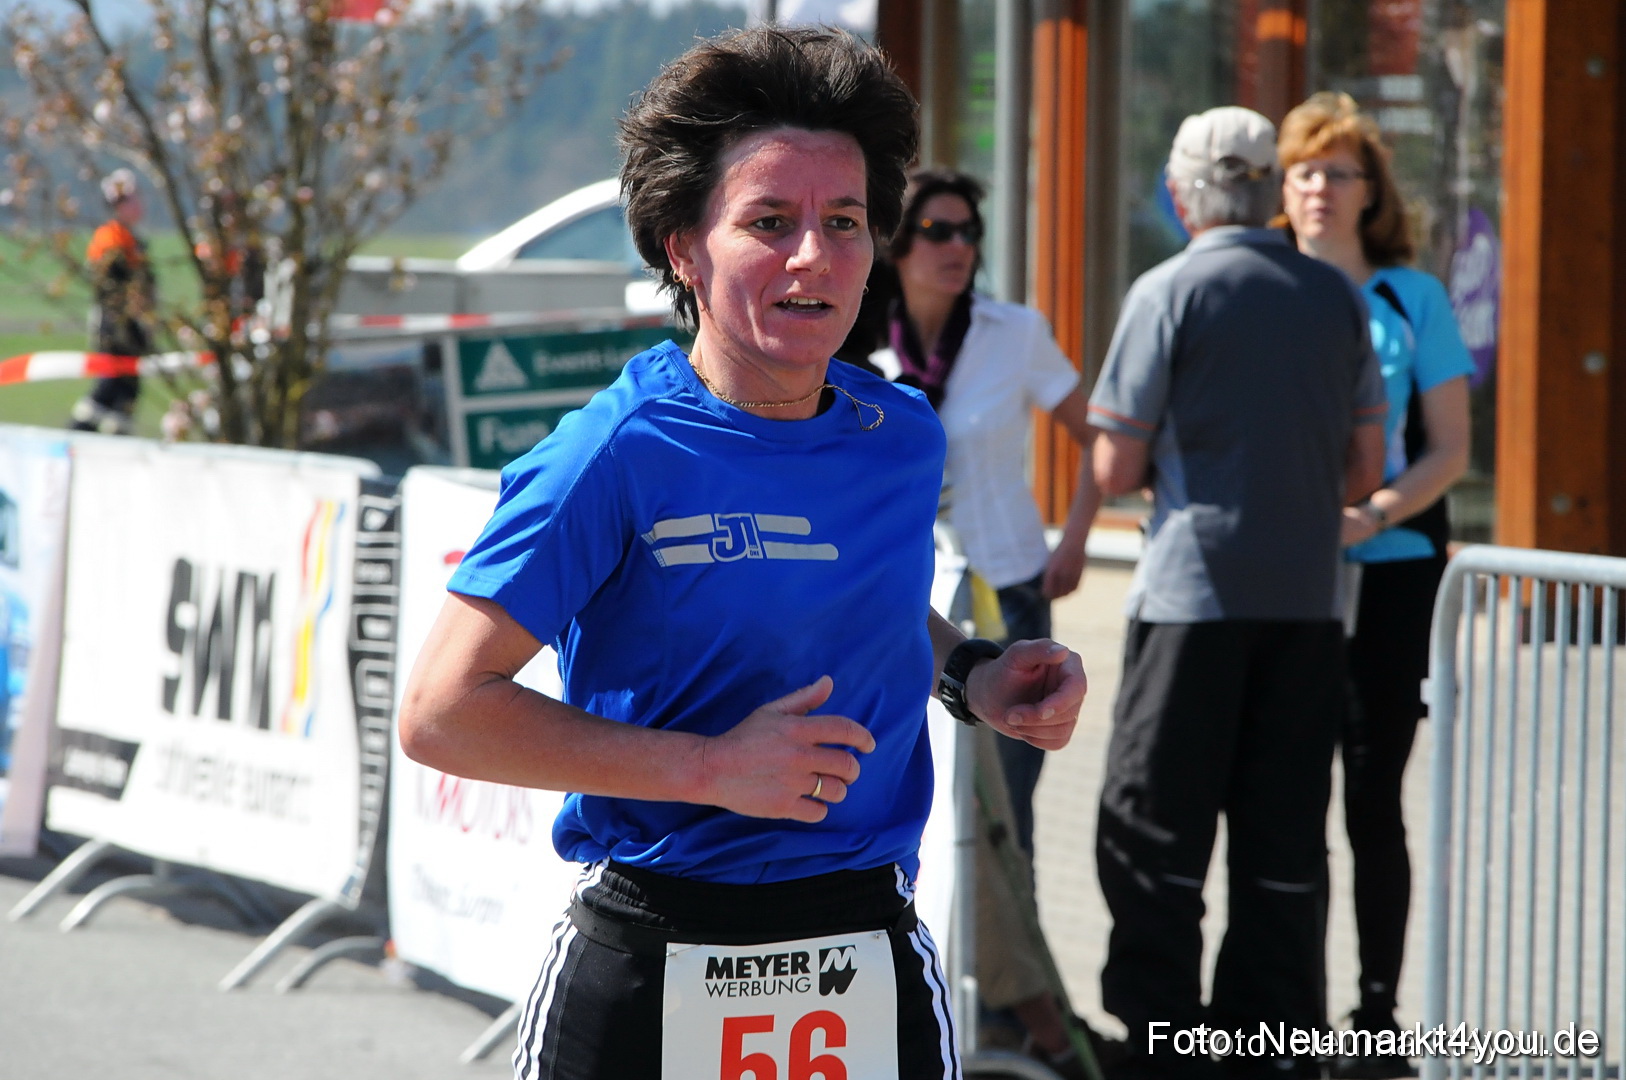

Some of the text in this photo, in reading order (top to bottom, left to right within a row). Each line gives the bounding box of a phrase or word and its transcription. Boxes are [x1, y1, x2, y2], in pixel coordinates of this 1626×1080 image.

[705, 951, 811, 980] MEYER
[705, 977, 812, 998] WERBUNG
[720, 1010, 847, 1080] 56
